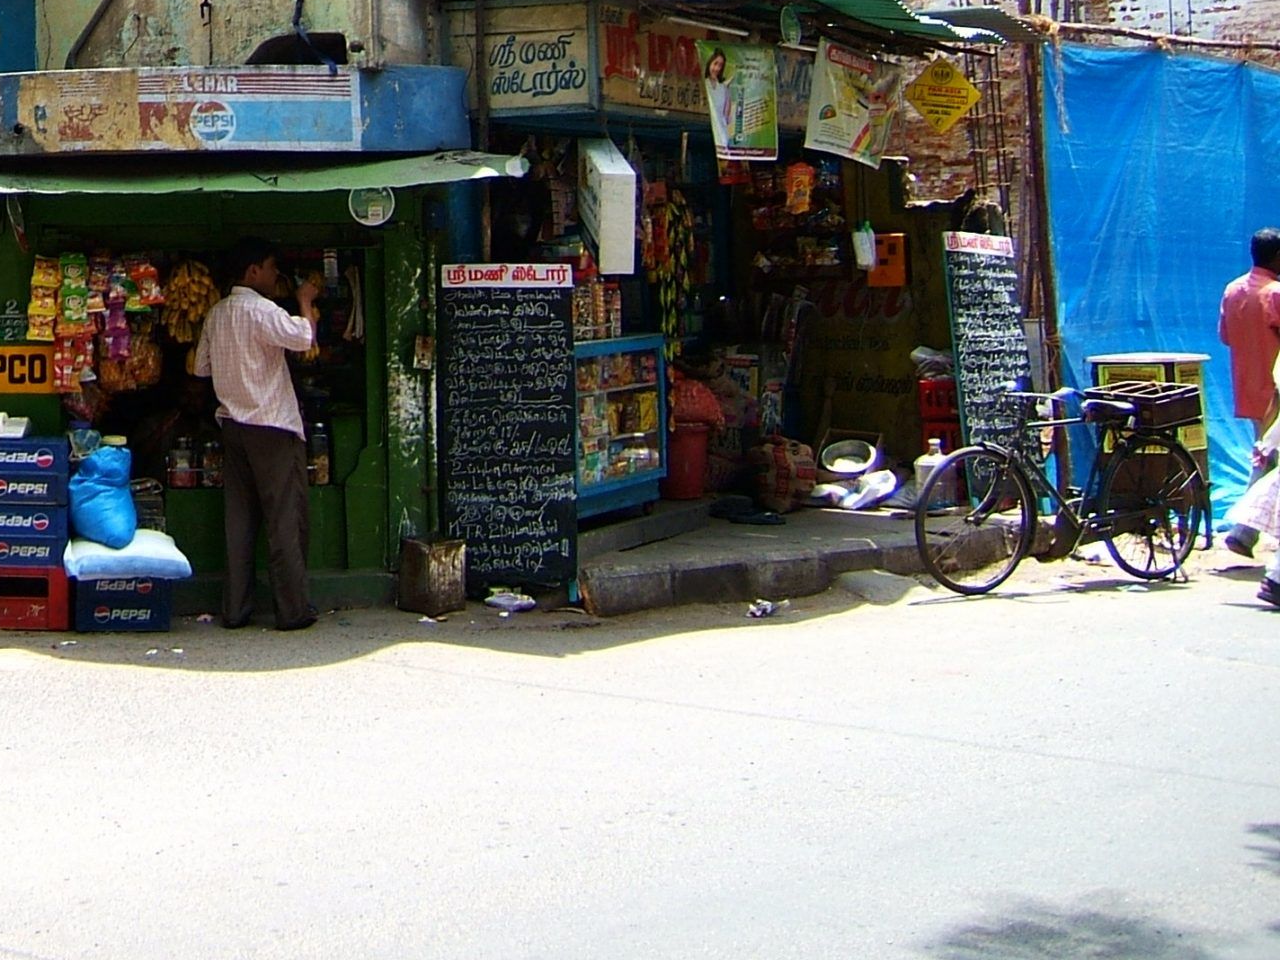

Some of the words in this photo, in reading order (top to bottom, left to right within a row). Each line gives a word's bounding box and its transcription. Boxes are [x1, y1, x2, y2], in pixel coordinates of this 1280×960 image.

[519, 32, 576, 65] மணி
[182, 75, 239, 93] LEHAR
[491, 60, 587, 97] ஸ்டோர்ஸ்
[193, 113, 234, 129] PEPSI
[469, 265, 508, 281] மணி
[511, 265, 568, 284] ஸ்டோர்
[8, 483, 48, 495] PEPSI
[10, 546, 50, 557] PEPSI
[96, 580, 135, 591] PEPSI
[111, 609, 151, 620] PEPSI
